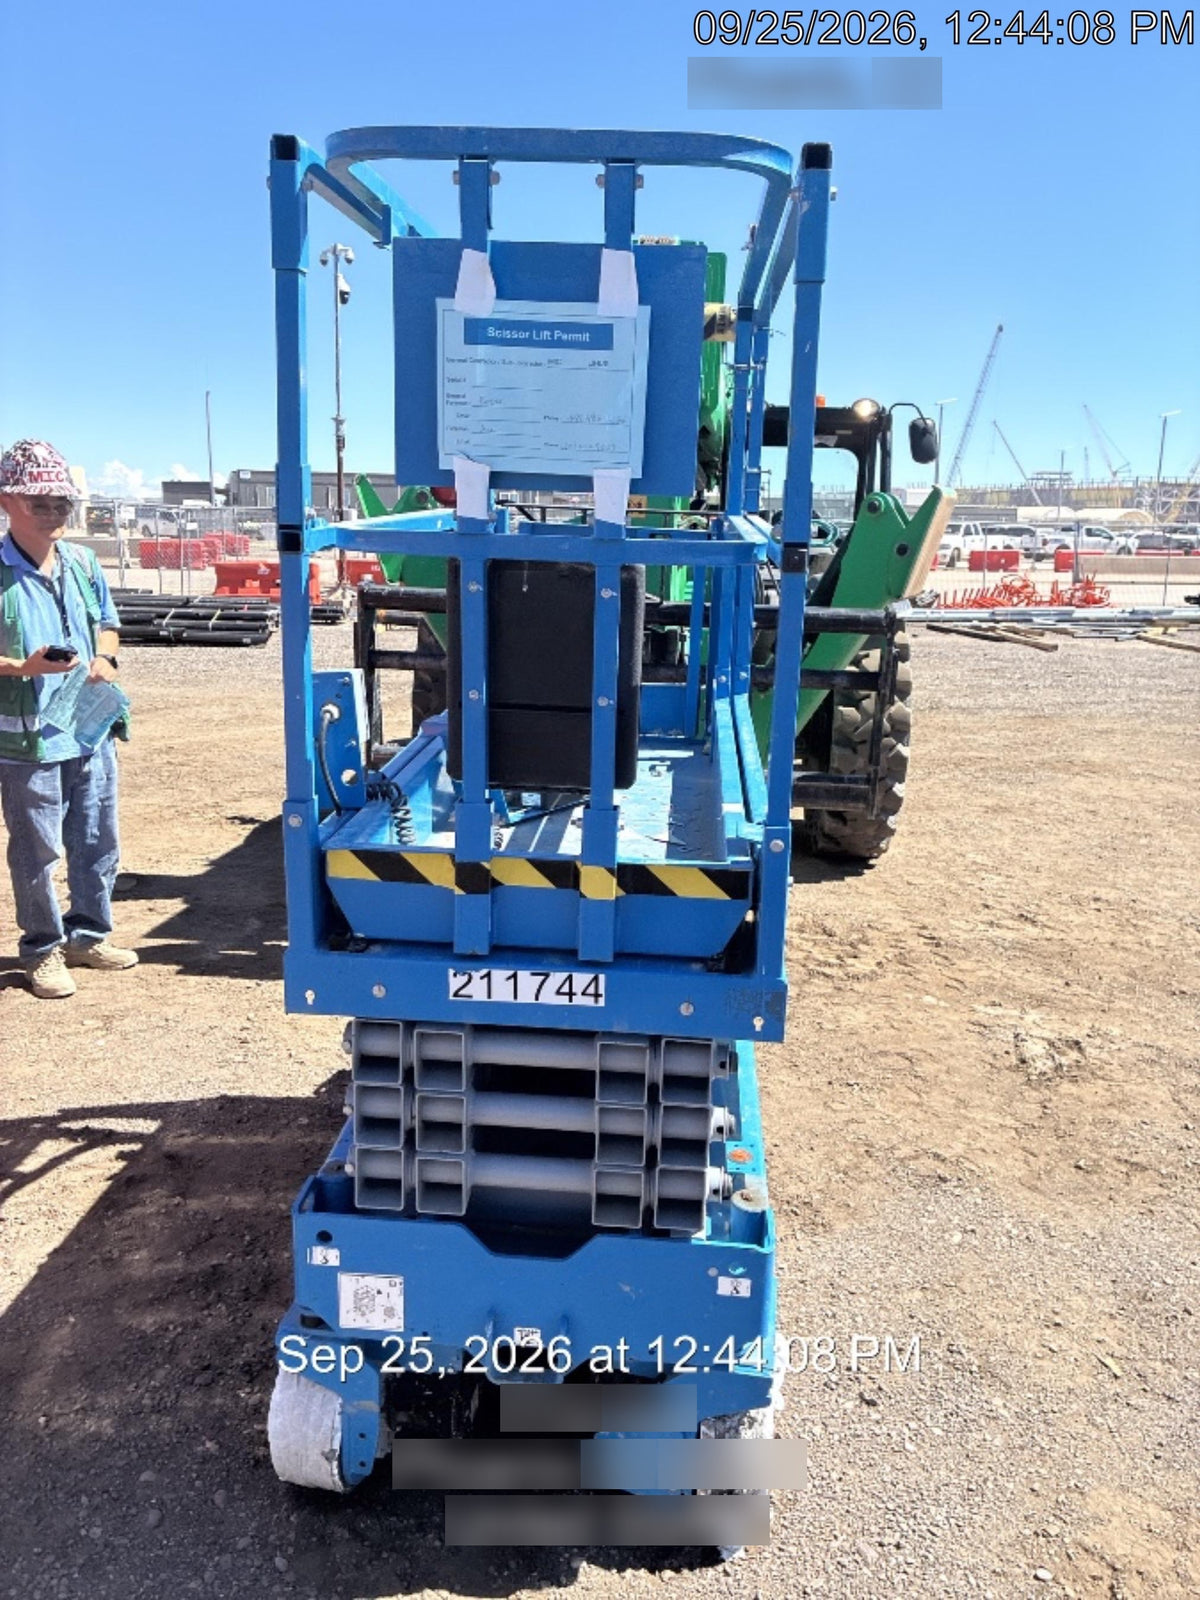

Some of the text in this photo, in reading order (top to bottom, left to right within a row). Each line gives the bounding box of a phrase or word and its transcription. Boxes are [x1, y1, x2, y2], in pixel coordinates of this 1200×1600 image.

[487, 326, 590, 342] Scissor Lift Permit
[452, 970, 603, 1004] 211744
